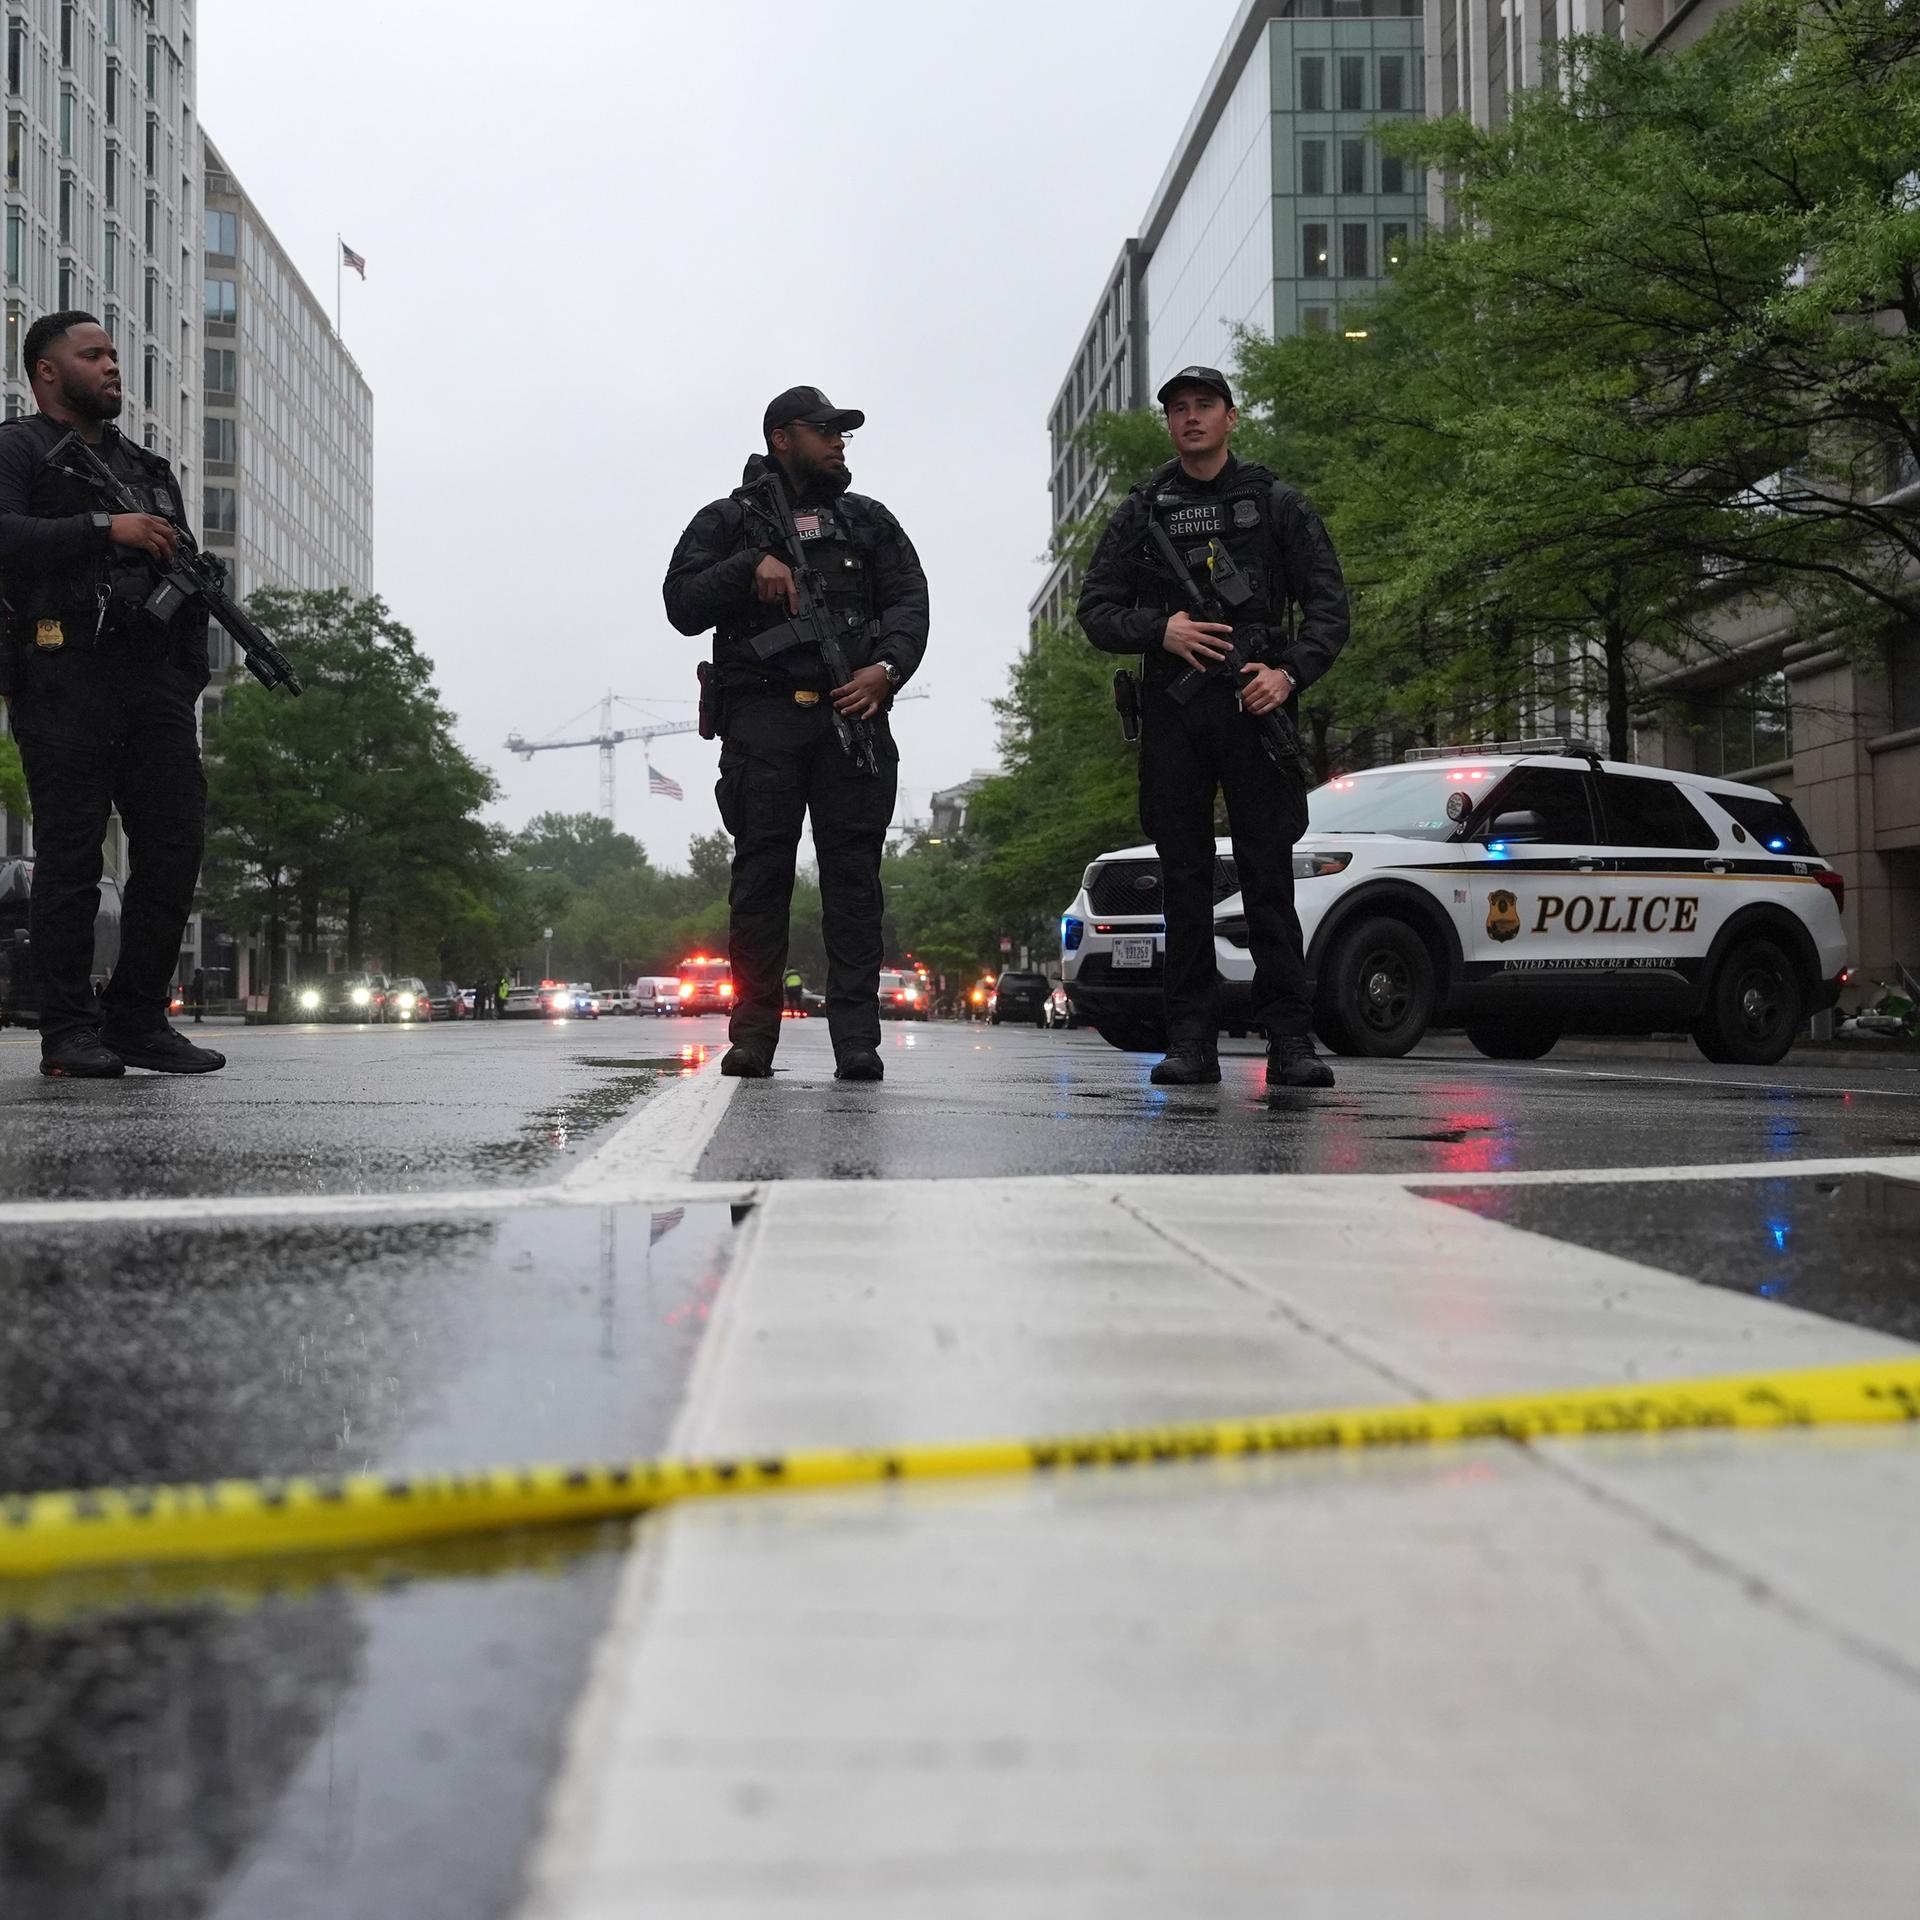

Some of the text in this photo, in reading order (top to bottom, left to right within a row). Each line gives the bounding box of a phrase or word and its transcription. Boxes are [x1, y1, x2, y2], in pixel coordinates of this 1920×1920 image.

[1170, 506, 1217, 521] SECRET
[1169, 519, 1221, 534] SERVICE
[1531, 895, 1700, 934] POLICE
[1503, 957, 1677, 970] UNITED STATES SECRET SERVICE
